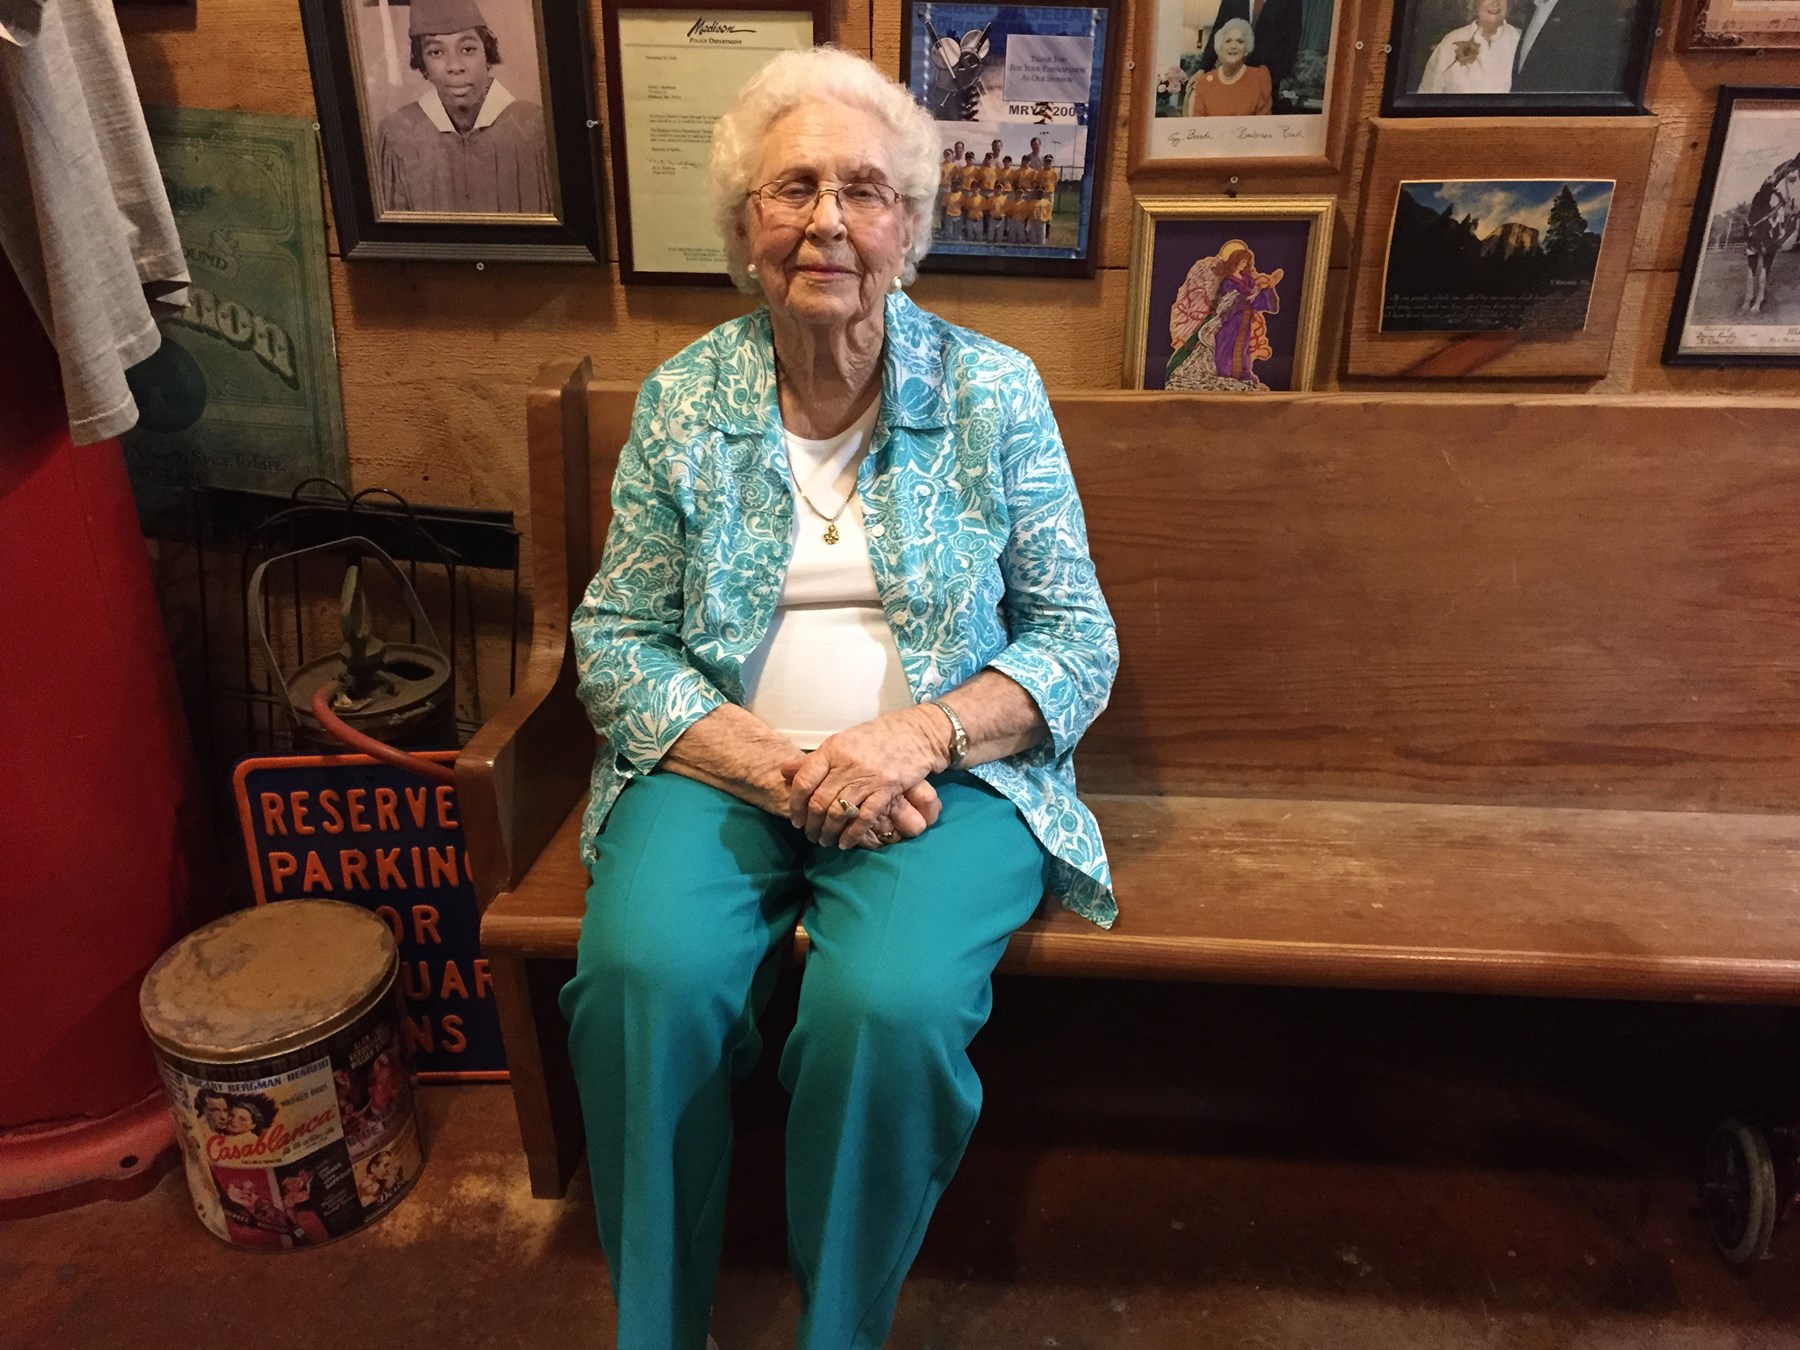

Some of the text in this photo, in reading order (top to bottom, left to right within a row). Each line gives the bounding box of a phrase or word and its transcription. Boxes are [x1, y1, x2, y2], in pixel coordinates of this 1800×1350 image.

[687, 16, 757, 37] Madison
[183, 246, 228, 271] OUND
[260, 786, 459, 836] RESERVE
[228, 1077, 282, 1093] BERGMAN
[206, 1110, 335, 1163] Casablanca
